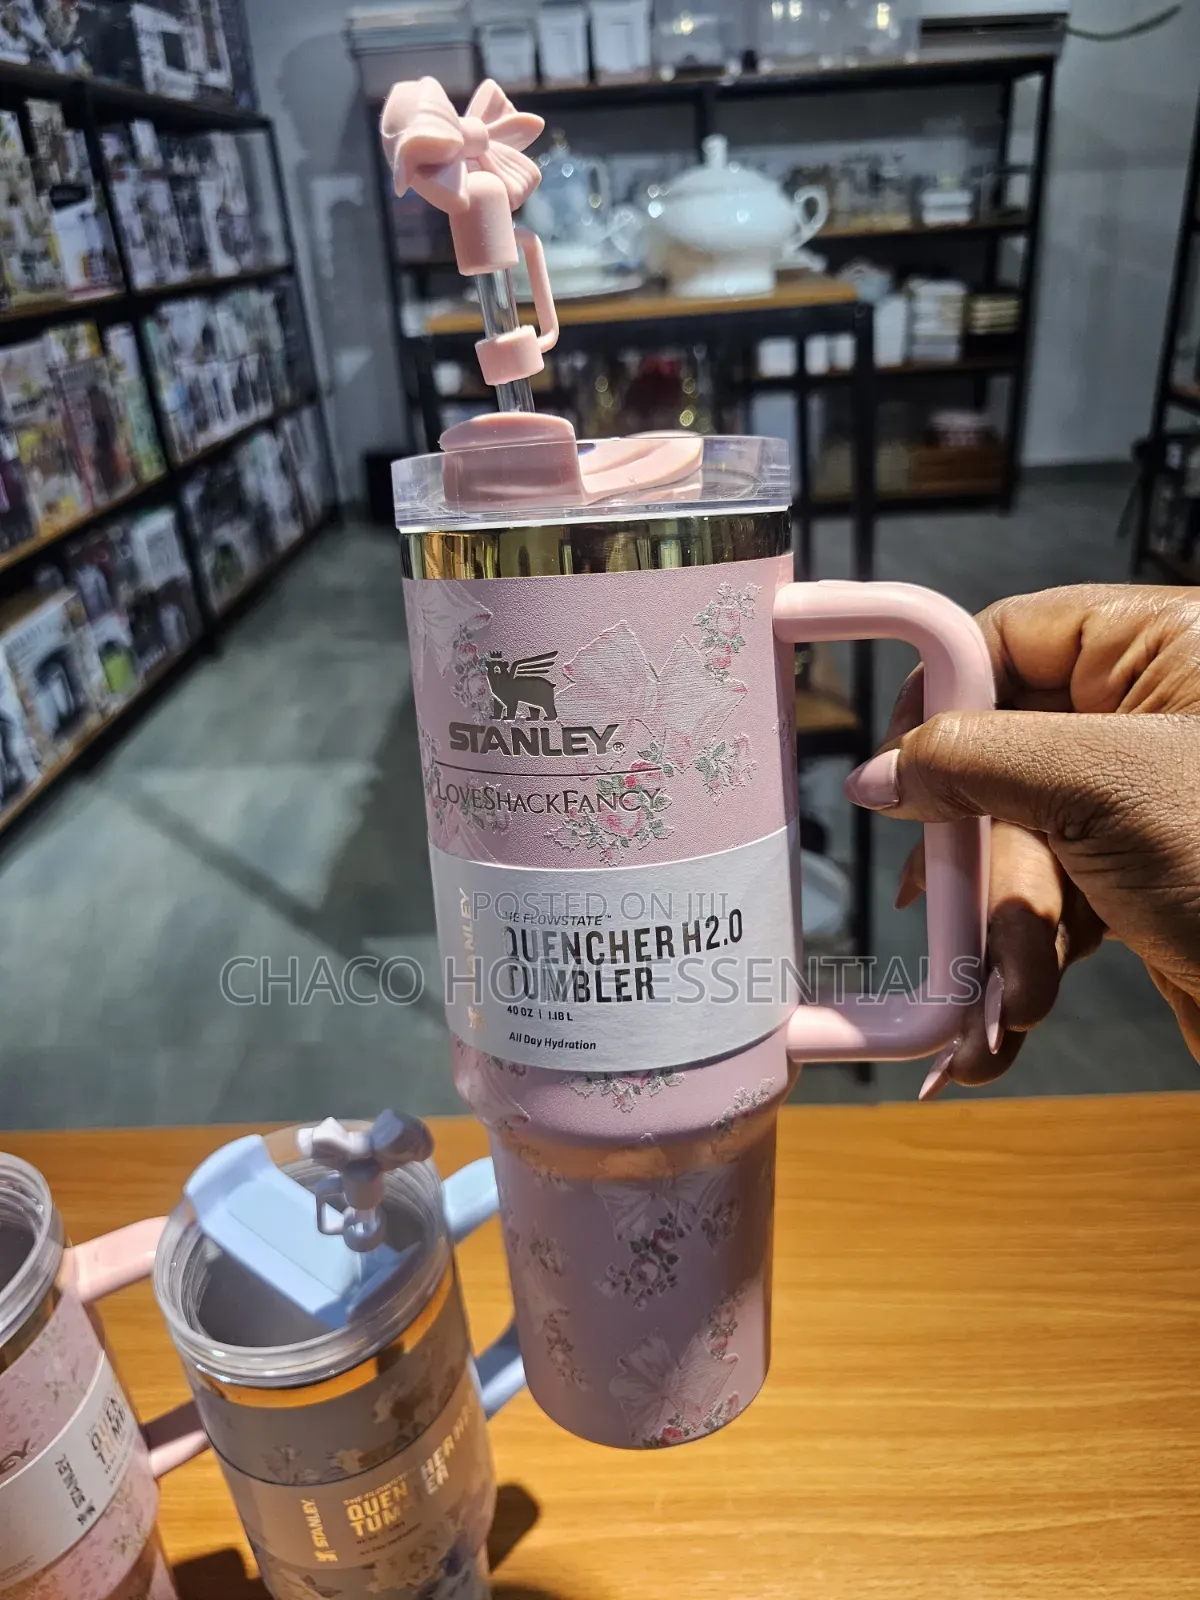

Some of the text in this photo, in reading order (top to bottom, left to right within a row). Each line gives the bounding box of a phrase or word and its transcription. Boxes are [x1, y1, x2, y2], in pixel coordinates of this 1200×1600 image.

[502, 908, 743, 966] QUENCHER H2.0
[505, 964, 656, 1003] TUMBLER
[507, 1005, 519, 1015] 40
[521, 1008, 534, 1018] OZ
[548, 1011, 564, 1021] 1.18
[567, 1012, 574, 1021] L
[508, 1032, 597, 1051] All Day Hydration
